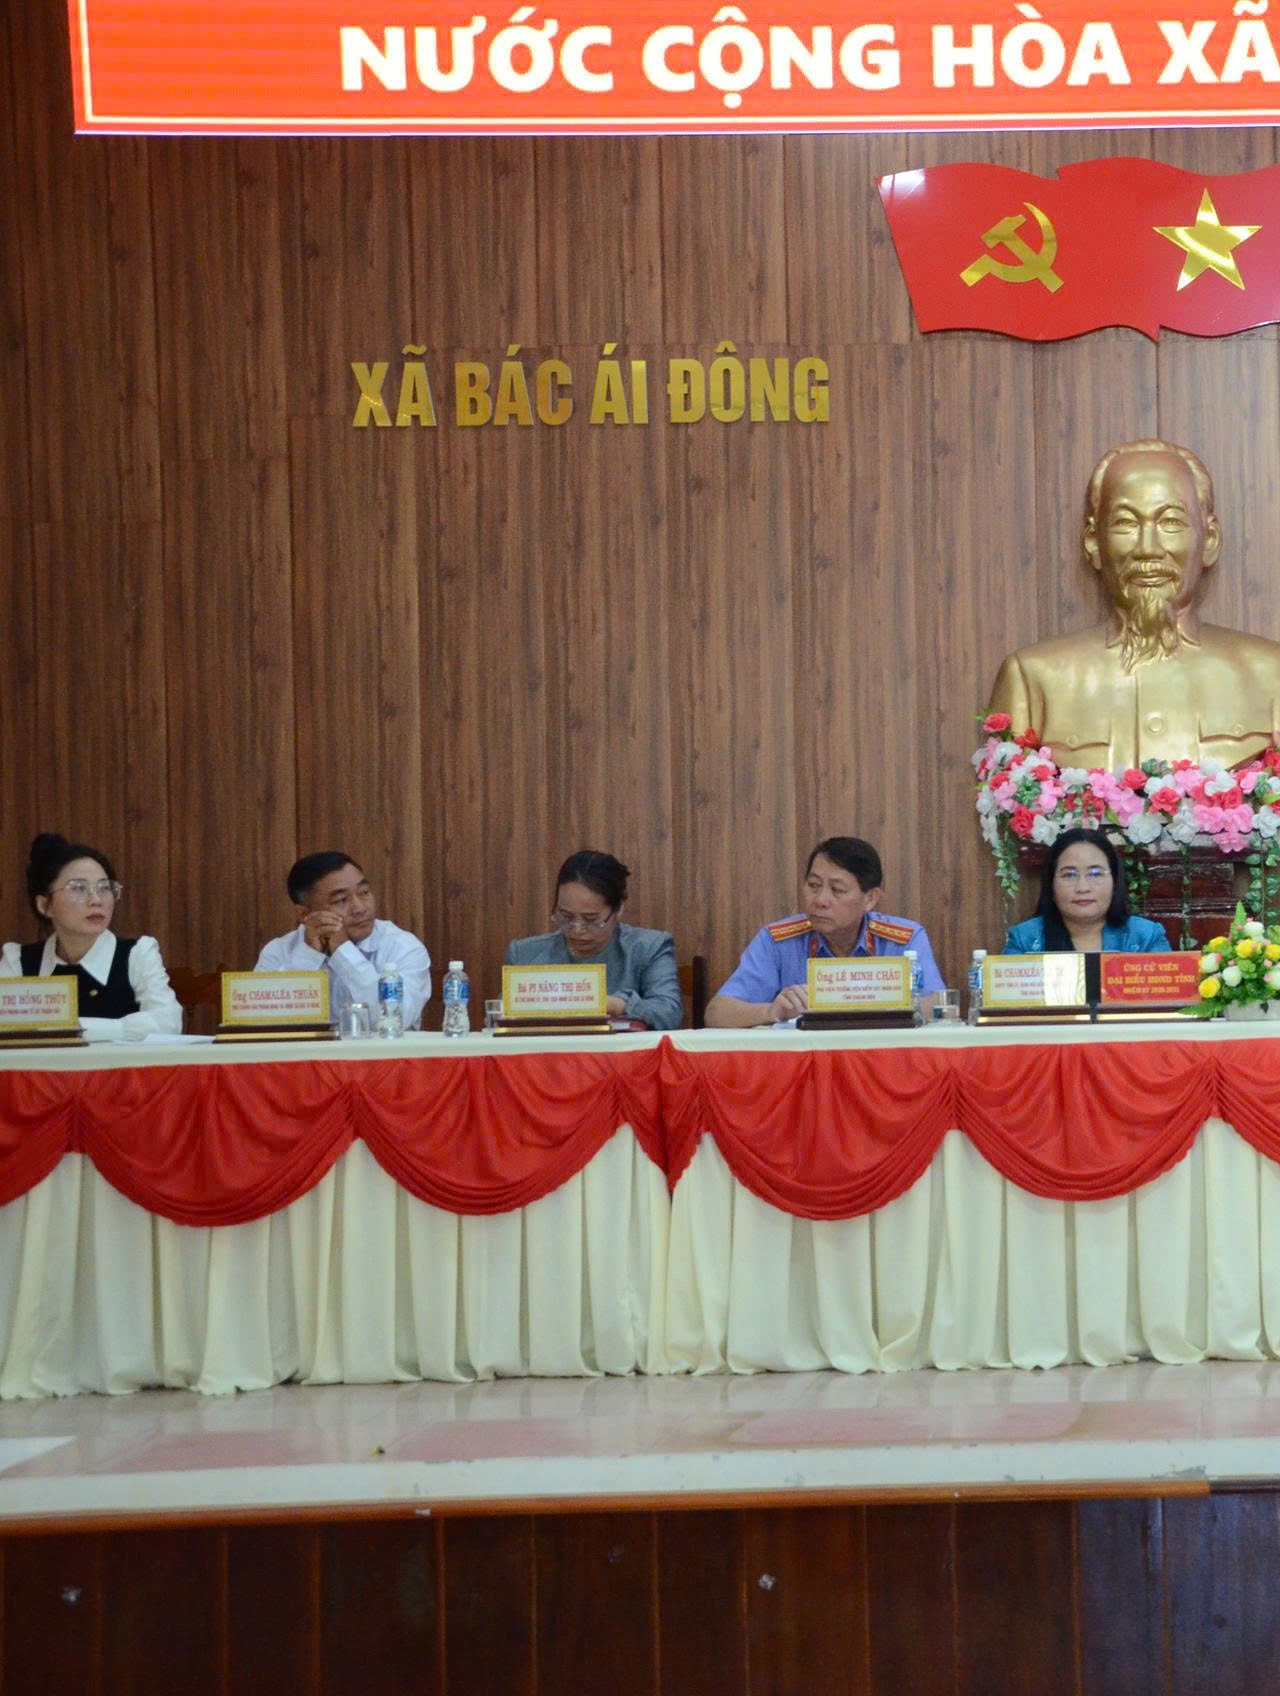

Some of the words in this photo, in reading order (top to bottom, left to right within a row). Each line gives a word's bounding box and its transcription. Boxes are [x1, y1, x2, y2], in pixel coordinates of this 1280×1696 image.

[341, 8, 613, 92] NƯỚC
[644, 7, 900, 108] CỘNG
[933, 4, 1131, 87] HÒA
[351, 344, 437, 427] XÃ
[454, 344, 573, 427] BÁC
[590, 343, 649, 425] ÁI
[667, 340, 830, 424] ĐÔNG
